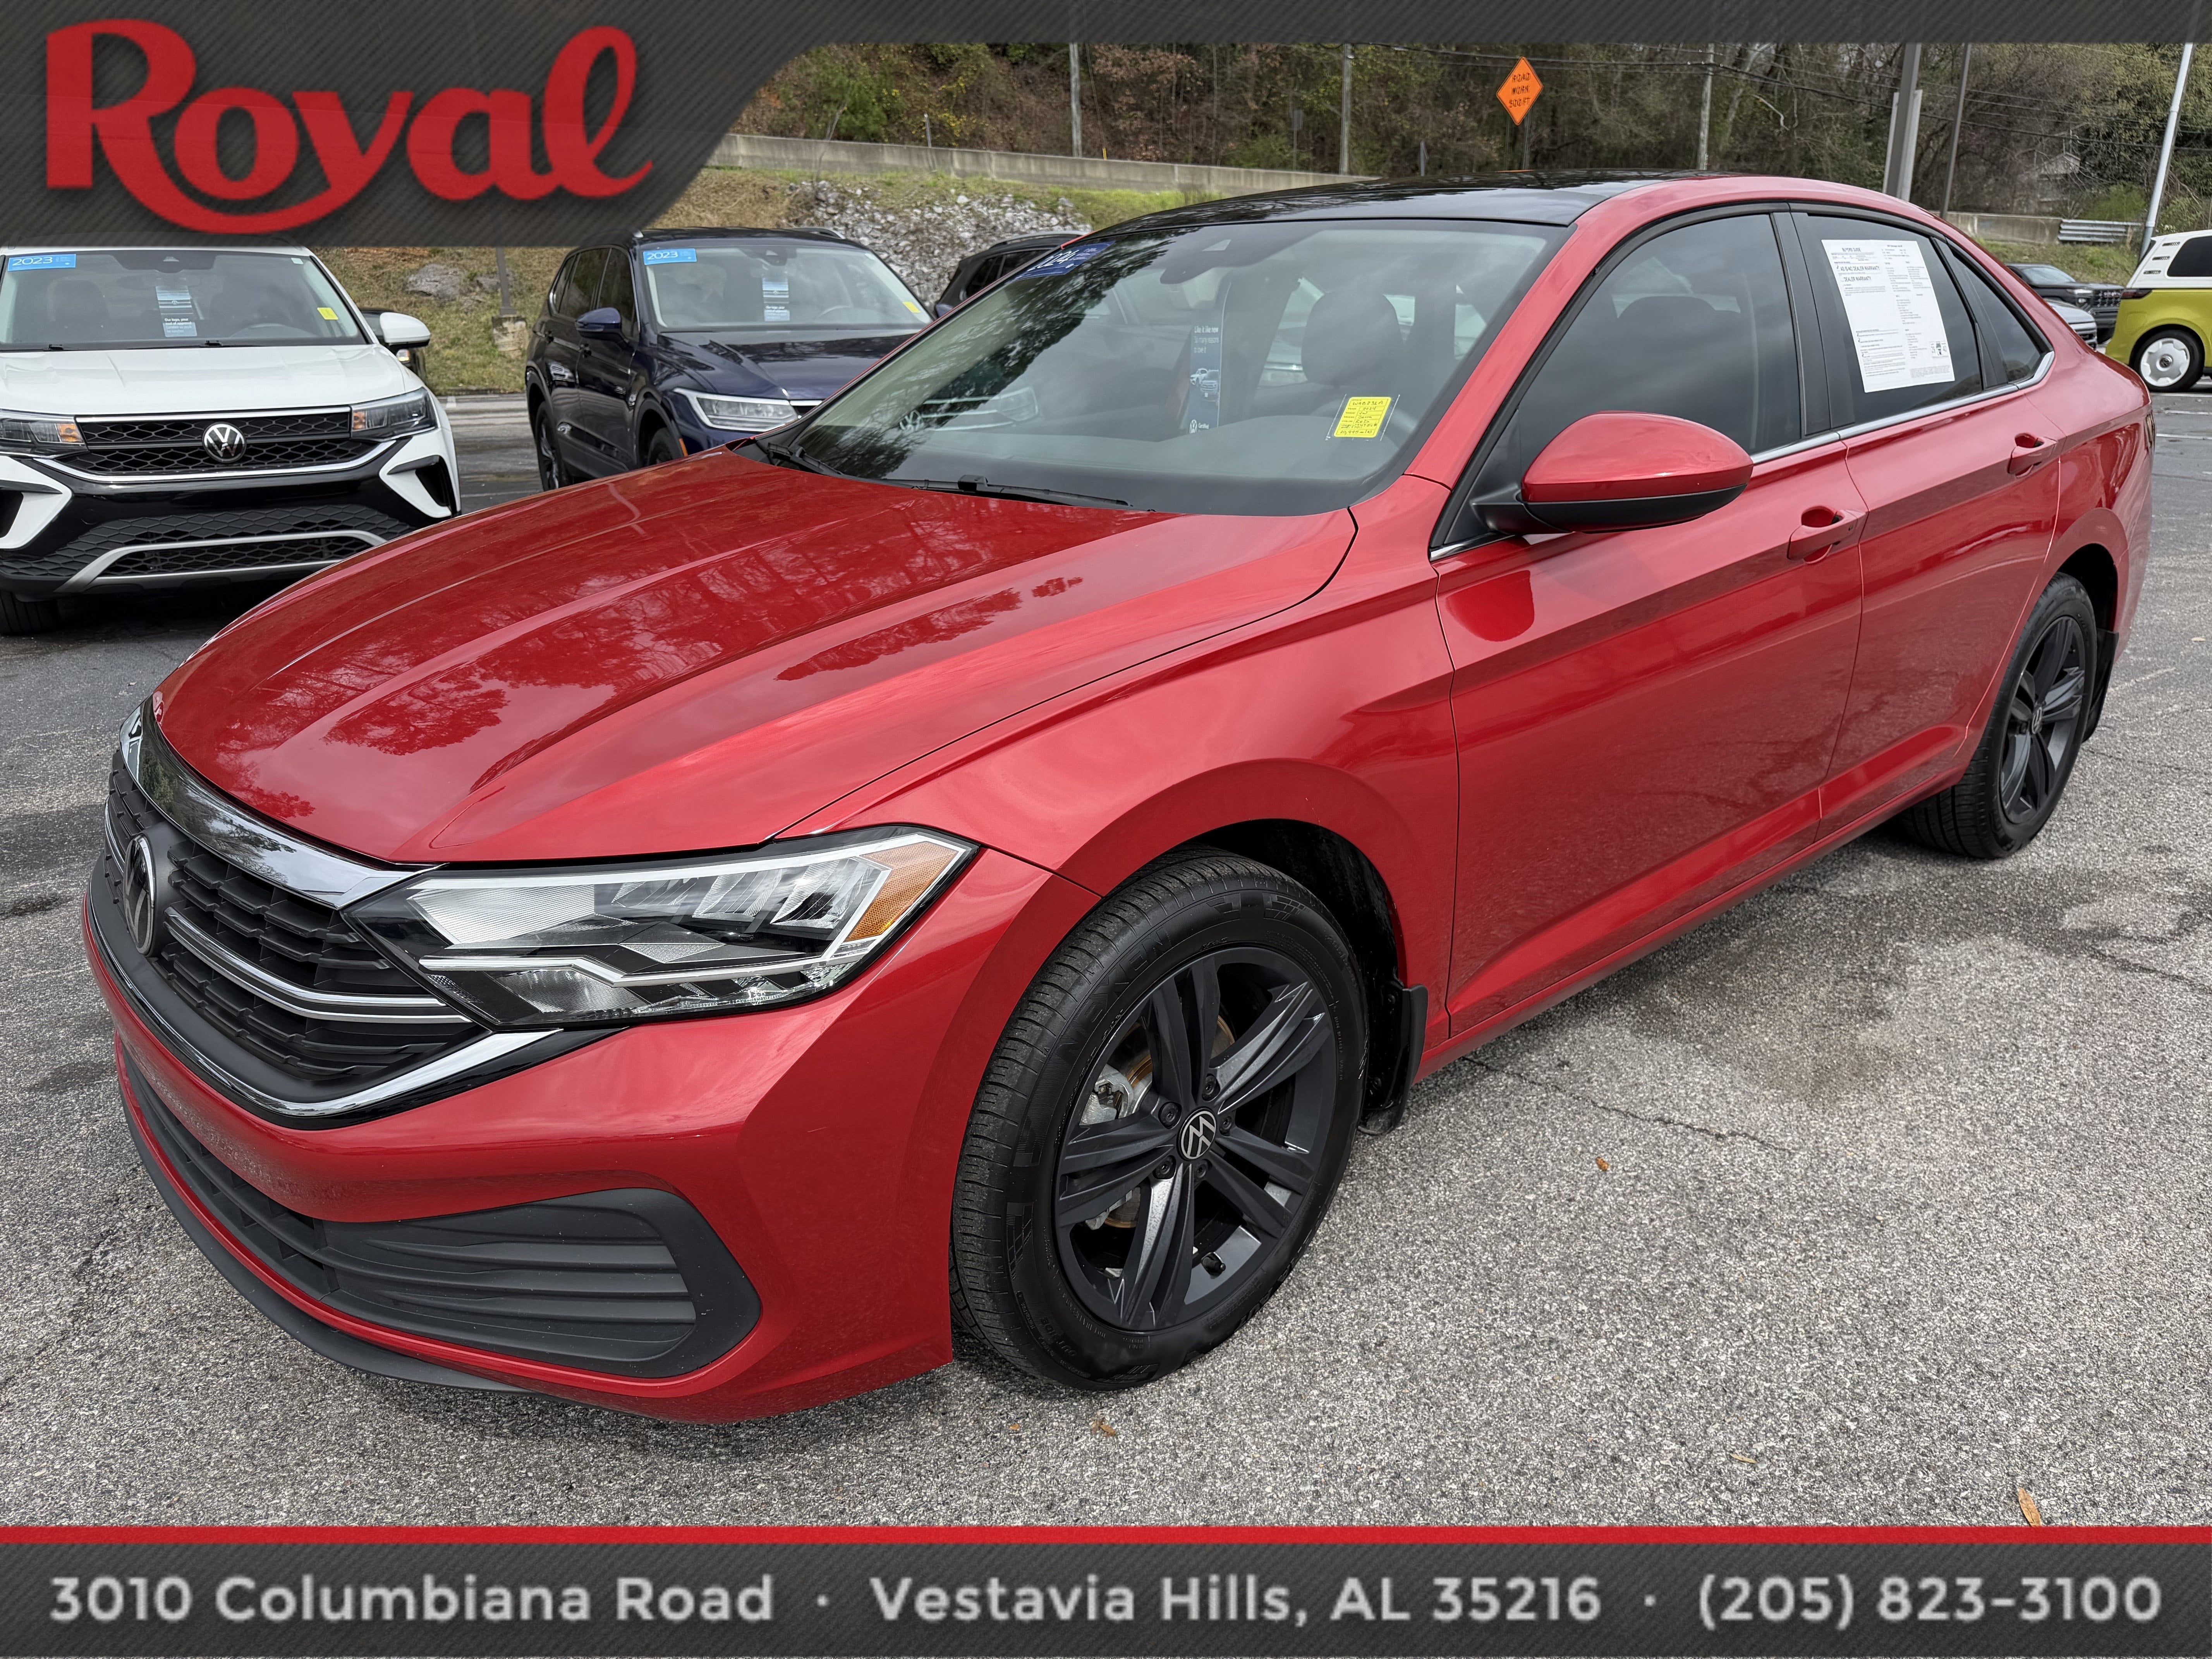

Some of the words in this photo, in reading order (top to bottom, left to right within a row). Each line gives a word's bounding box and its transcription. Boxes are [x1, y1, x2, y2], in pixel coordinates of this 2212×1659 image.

[1512, 72, 1531, 82] ROAD
[1511, 84, 1530, 95] WORK
[647, 251, 678, 260] 2023
[12, 256, 53, 266] 2023
[1056, 926, 1173, 1065] NEXEN
